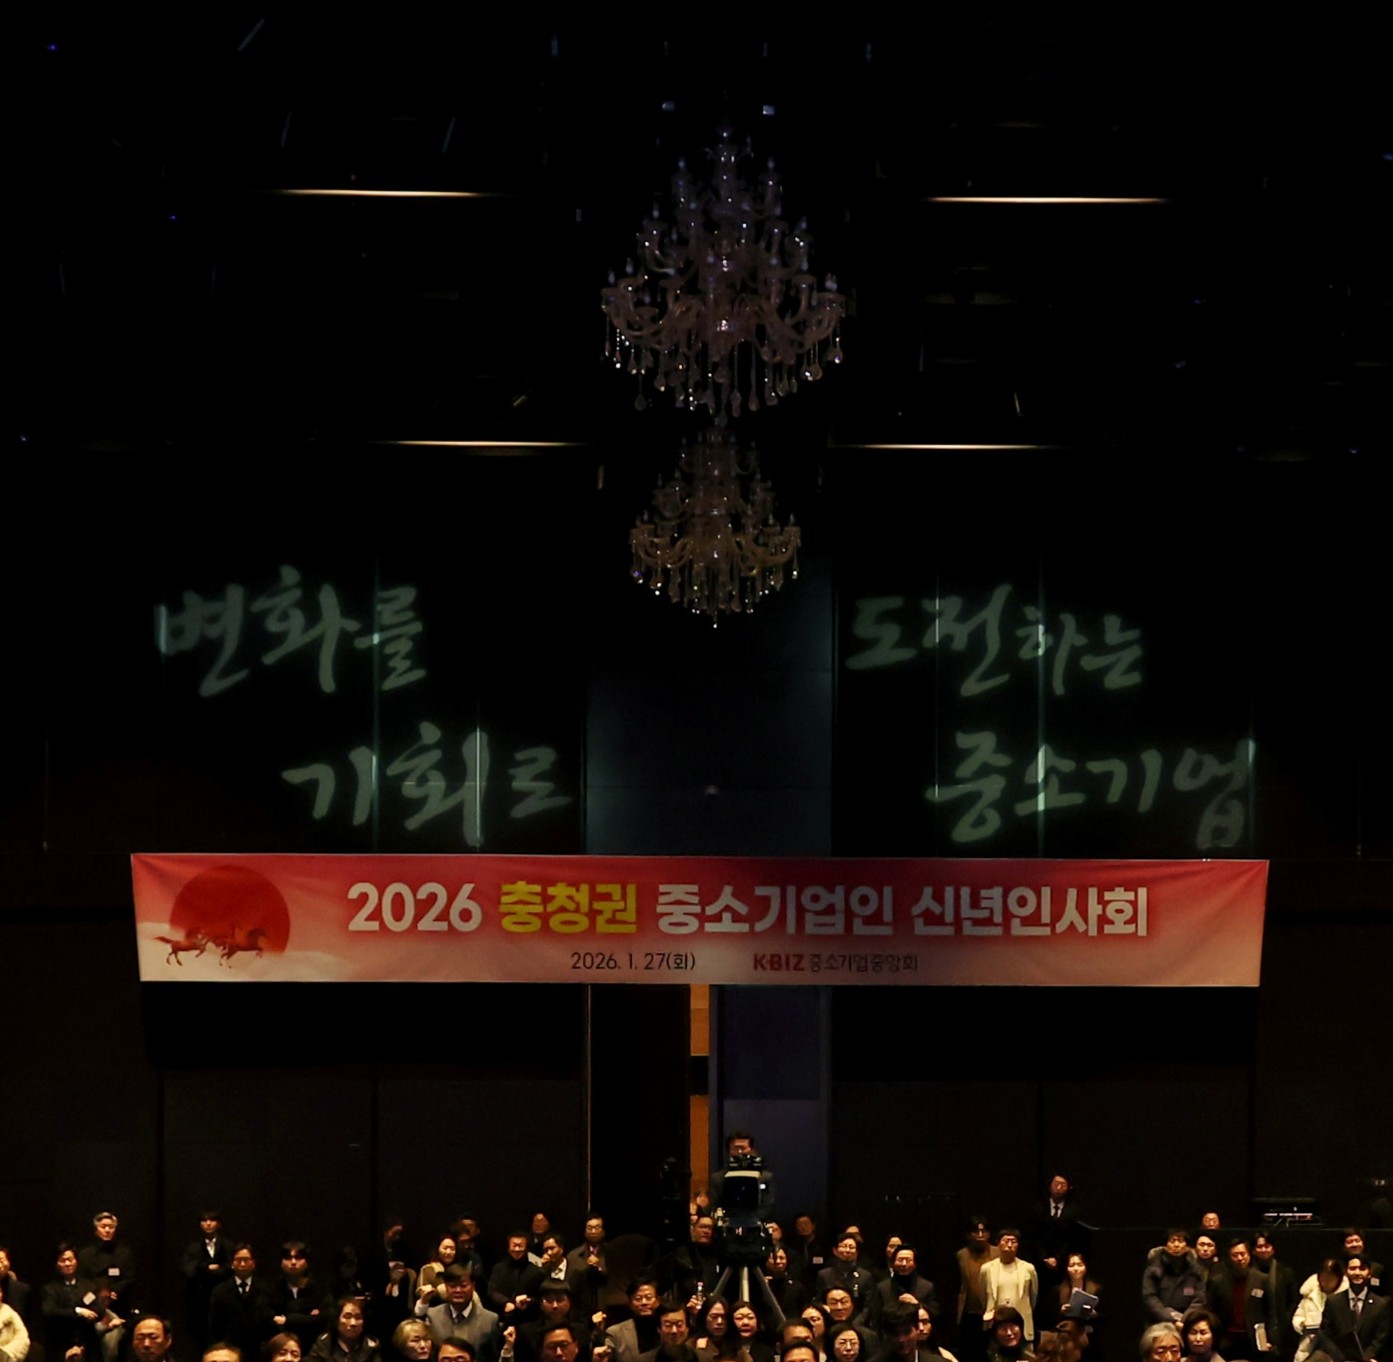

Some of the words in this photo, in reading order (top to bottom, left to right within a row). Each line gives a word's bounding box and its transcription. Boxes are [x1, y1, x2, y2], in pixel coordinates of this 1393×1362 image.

[154, 563, 426, 697] 변화를
[845, 583, 1143, 697] 도전하는
[281, 720, 572, 848] 기회로
[924, 730, 1256, 850] 중소기업
[346, 881, 483, 932] 2026
[498, 880, 637, 934] 충청권
[655, 882, 894, 936] 중소기업인
[911, 885, 1149, 937] 신년인사회
[570, 952, 621, 970] 2026.
[809, 953, 919, 973] 중소기업중앙회
